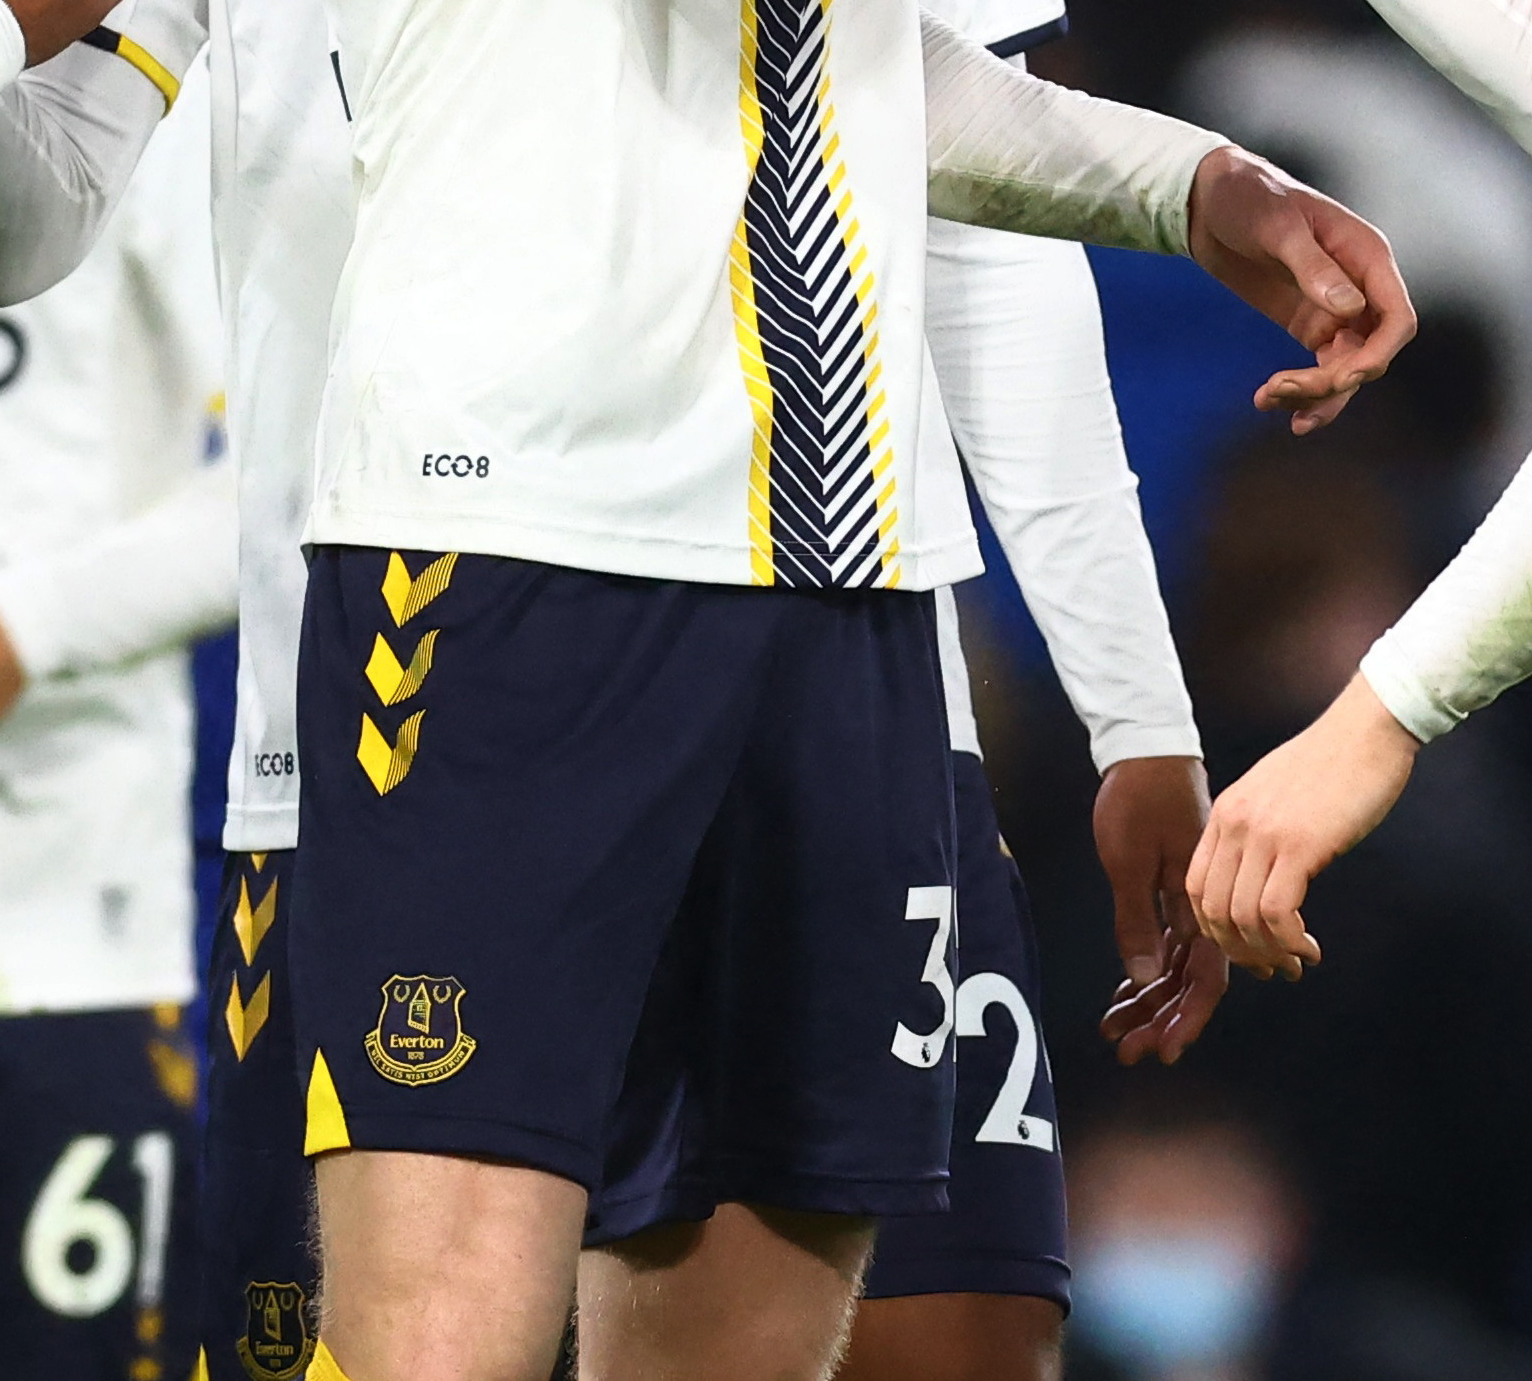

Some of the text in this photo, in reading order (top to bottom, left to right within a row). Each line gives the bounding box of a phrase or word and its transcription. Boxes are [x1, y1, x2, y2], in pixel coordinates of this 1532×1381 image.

[422, 453, 490, 478] ECO8
[390, 1033, 444, 1049] Everton
[19, 1131, 176, 1317] 61
